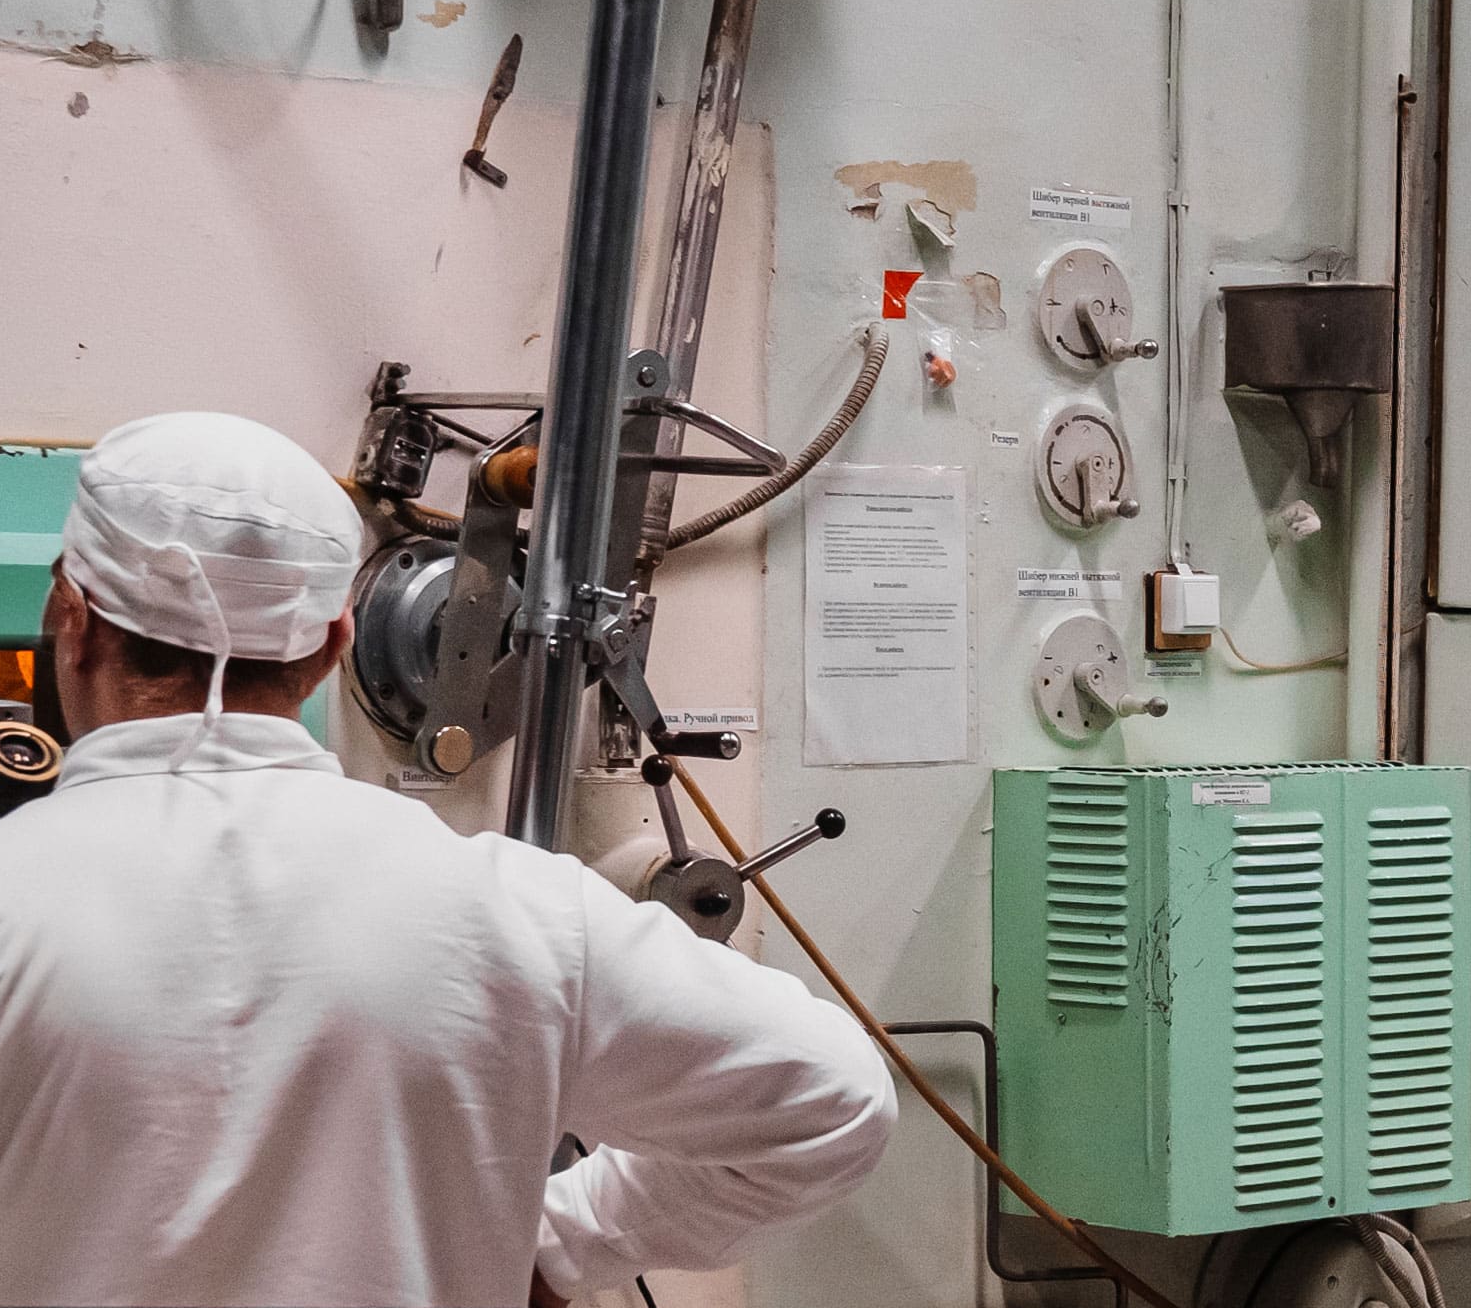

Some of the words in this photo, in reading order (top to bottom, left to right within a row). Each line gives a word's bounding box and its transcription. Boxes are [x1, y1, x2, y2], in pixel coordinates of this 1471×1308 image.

[1032, 190, 1061, 205] Шибер
[1018, 570, 1048, 584] Шибер
[1068, 587, 1078, 597] В1
[684, 712, 718, 726] Ручной
[720, 714, 754, 725] привод
